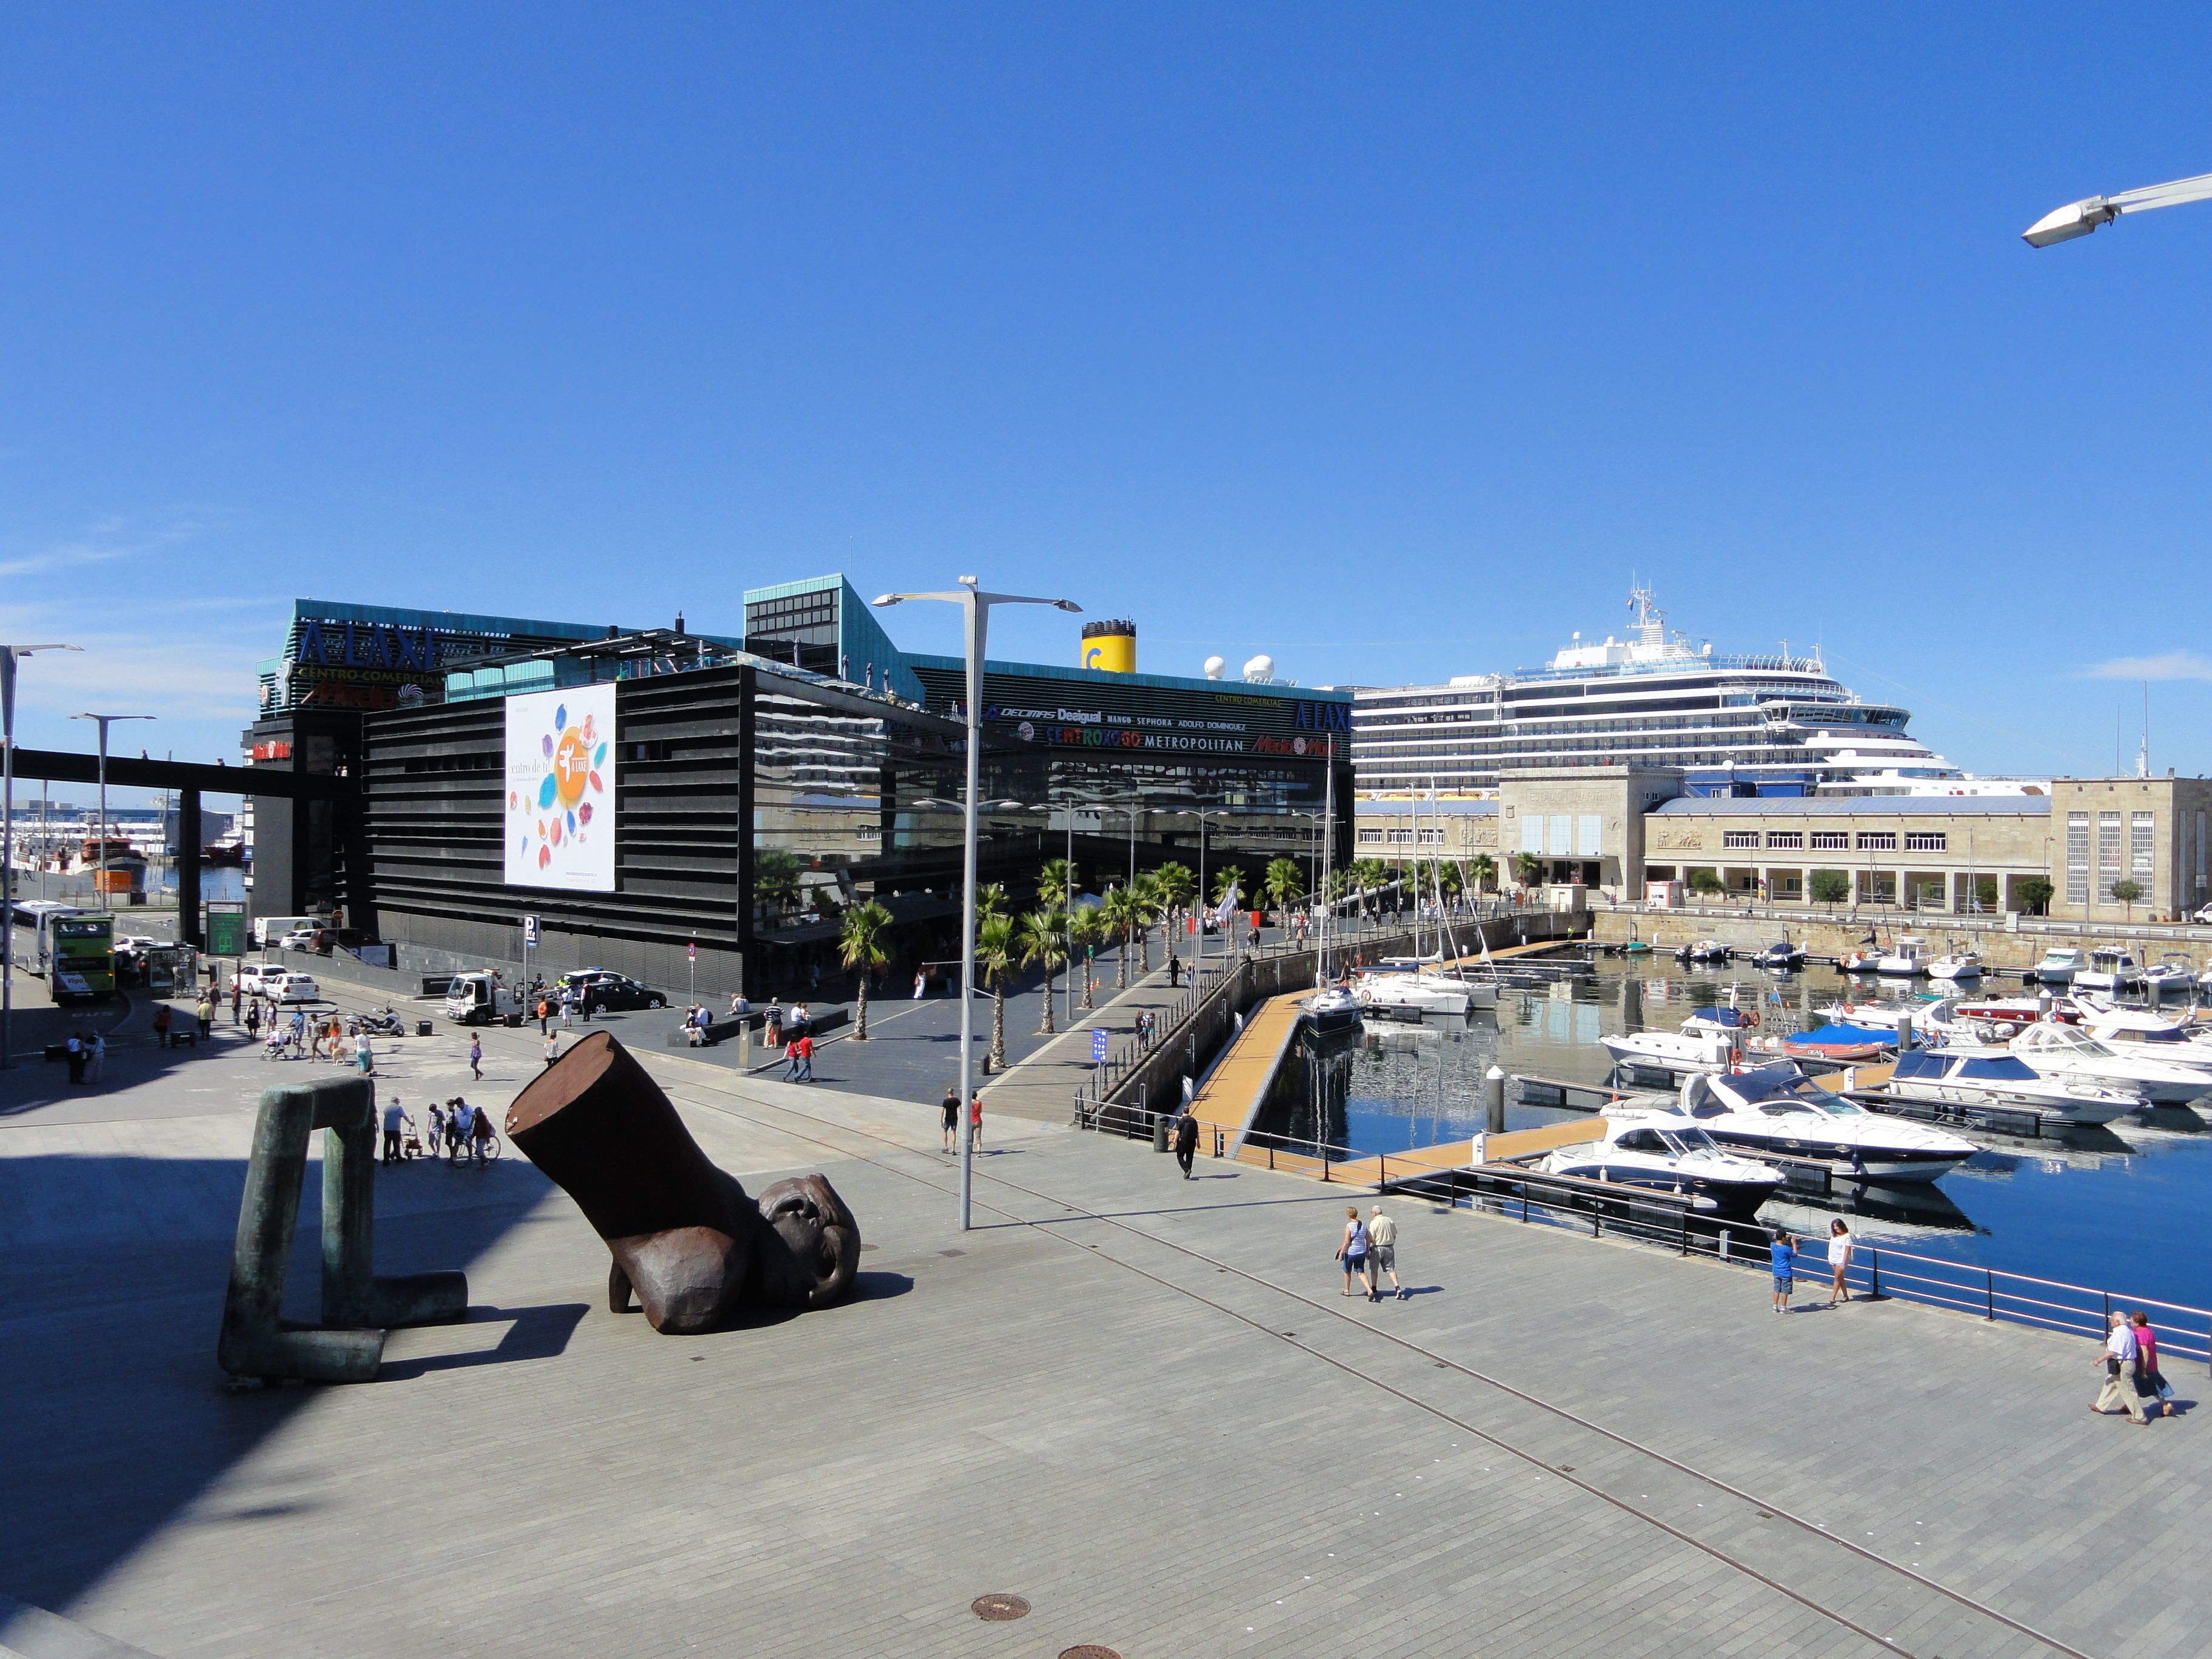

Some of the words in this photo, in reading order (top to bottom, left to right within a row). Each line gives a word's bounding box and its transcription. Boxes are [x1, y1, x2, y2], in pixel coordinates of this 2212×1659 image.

[299, 621, 328, 664] A
[346, 623, 442, 671] LAXE
[299, 668, 360, 680] CENTRO
[1215, 695, 1242, 704] CENTRO
[1244, 697, 1281, 706] COMERCIAL
[1000, 708, 1057, 719] DECIMAS
[1057, 708, 1101, 724] Desigual
[1107, 716, 1131, 724] MANGO
[1295, 701, 1307, 728] A
[1137, 717, 1172, 726] SEPHORA
[1178, 720, 1204, 728] ADOLFO
[1207, 722, 1245, 731] DOMINGUEZ
[1145, 736, 1243, 751] METROPOLITAN
[532, 759, 541, 773] de
[526, 916, 534, 936] P
